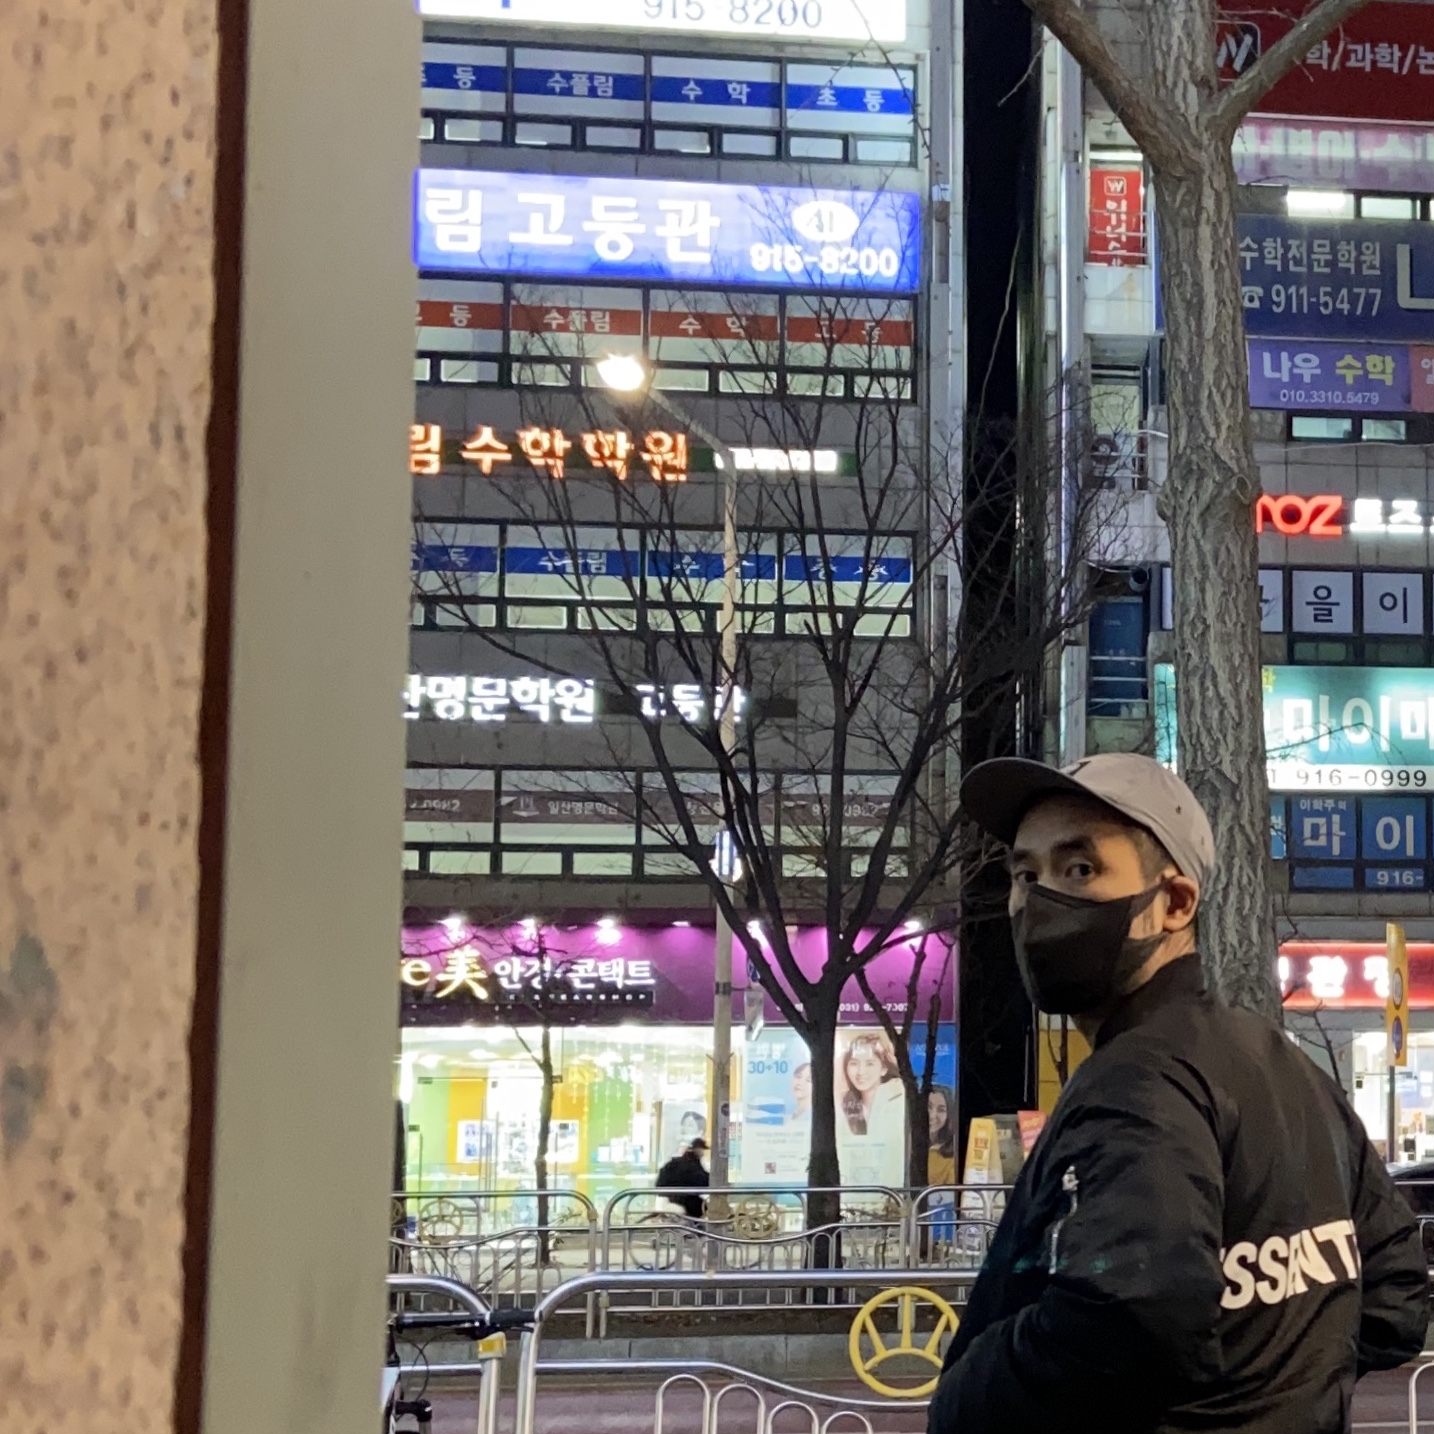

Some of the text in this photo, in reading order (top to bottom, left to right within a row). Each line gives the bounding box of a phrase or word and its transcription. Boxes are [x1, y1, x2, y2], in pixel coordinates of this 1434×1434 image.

[508, 192, 720, 263] 고등관
[750, 242, 899, 278] 915-8200
[1239, 236, 1382, 275] 수학전문학원
[1271, 286, 1382, 317] 911-5477
[1263, 351, 1396, 387] 나우 수학
[1296, 769, 1428, 787] 916-0999
